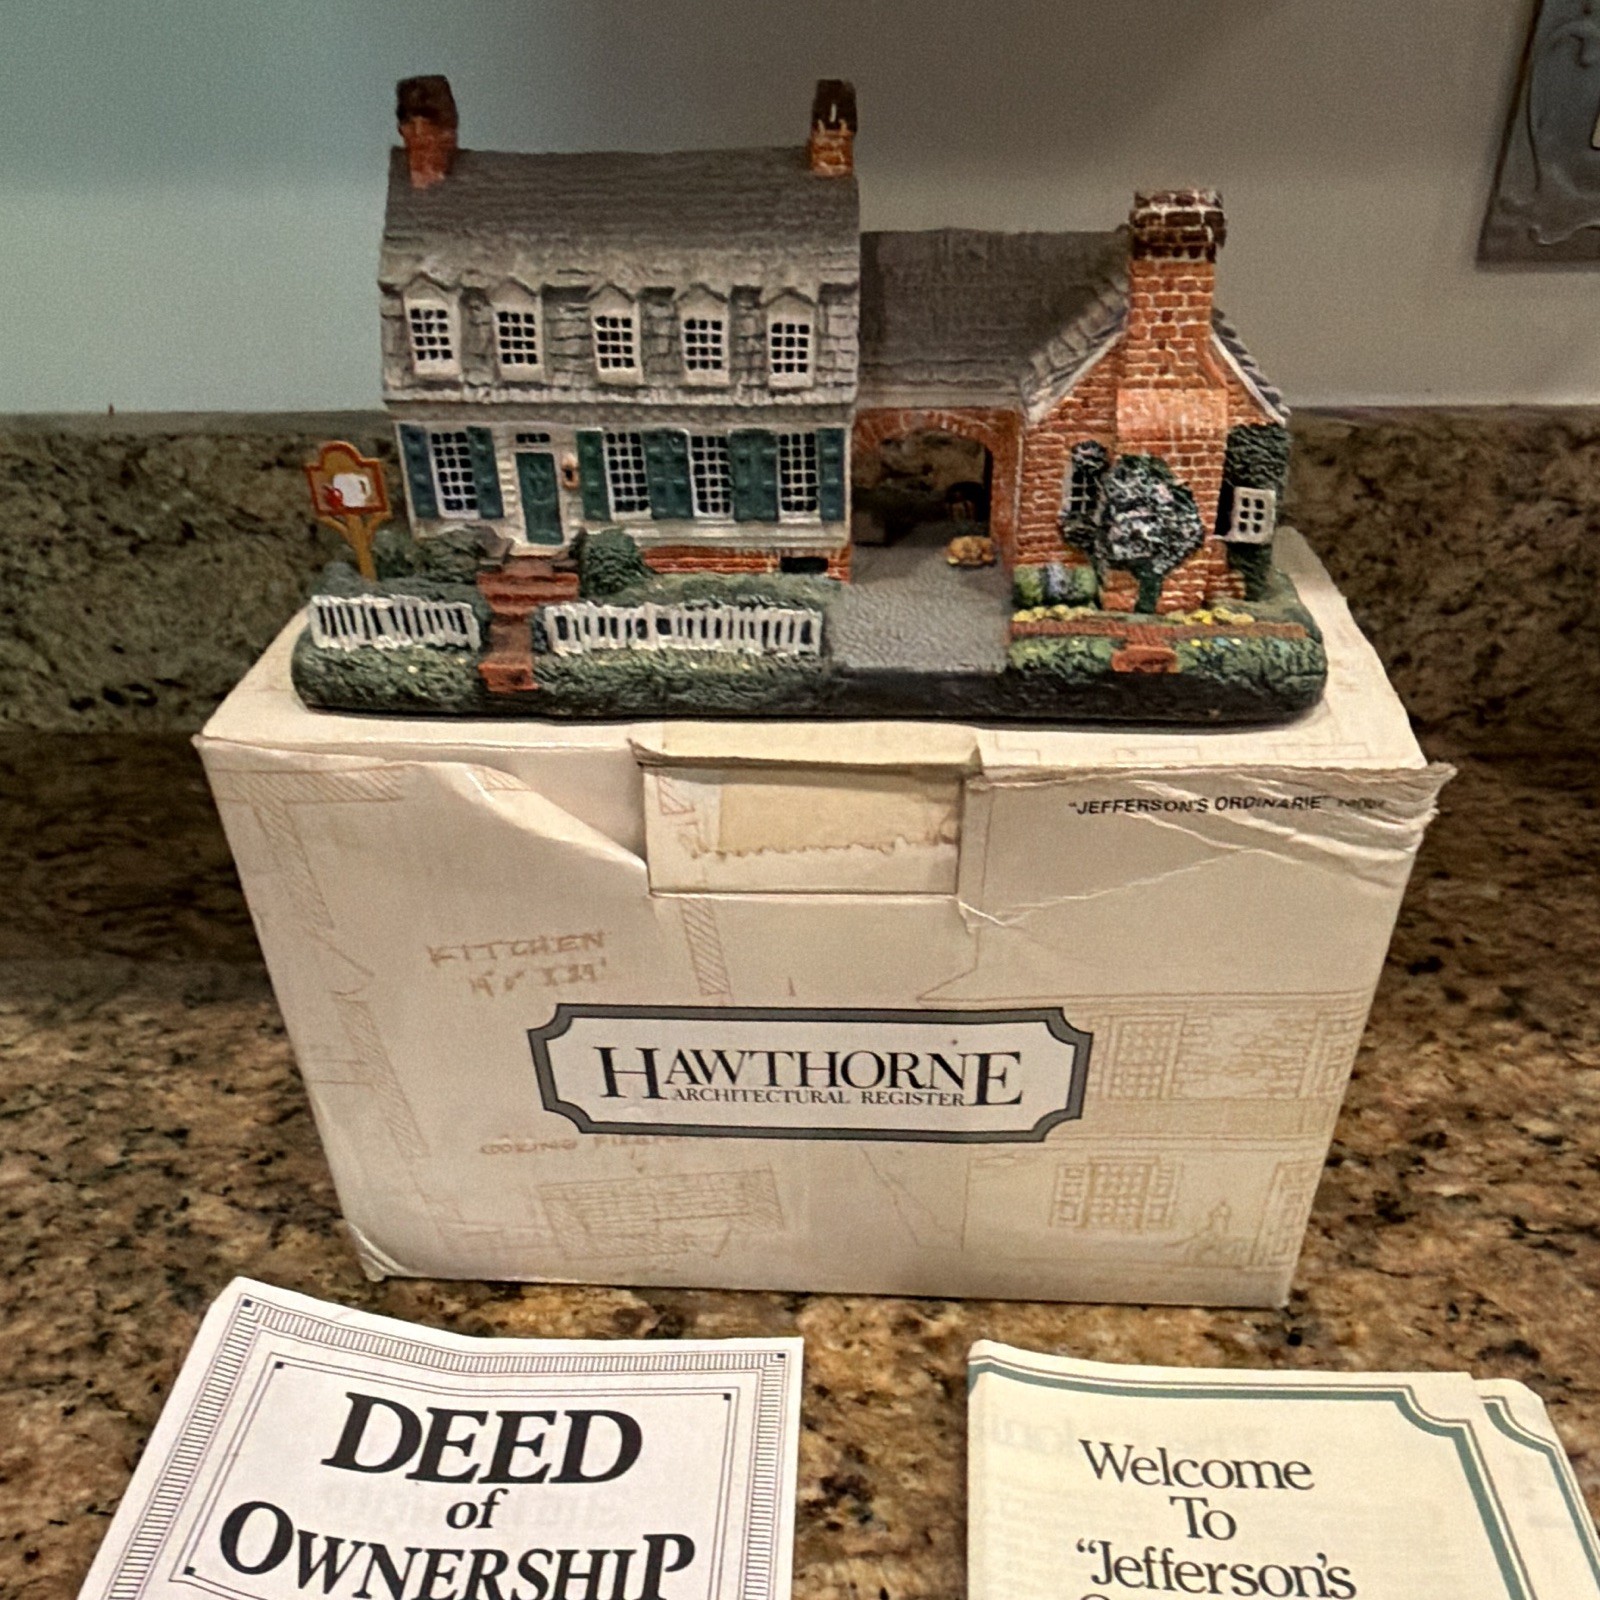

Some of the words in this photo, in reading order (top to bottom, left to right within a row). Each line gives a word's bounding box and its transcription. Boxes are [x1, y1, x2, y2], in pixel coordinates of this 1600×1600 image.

[592, 1046, 1022, 1107] HAWTHORNE
[673, 1087, 851, 1106] ARCHITECTURAL
[860, 1090, 966, 1108] REGISTER
[321, 1391, 643, 1485] DEED
[1078, 1438, 1316, 1492] Welcome
[446, 1488, 509, 1530] of
[1169, 1496, 1237, 1541] To
[220, 1500, 697, 1600] OWNERSHIP
[1076, 1537, 1358, 1600] "Jefferson's
